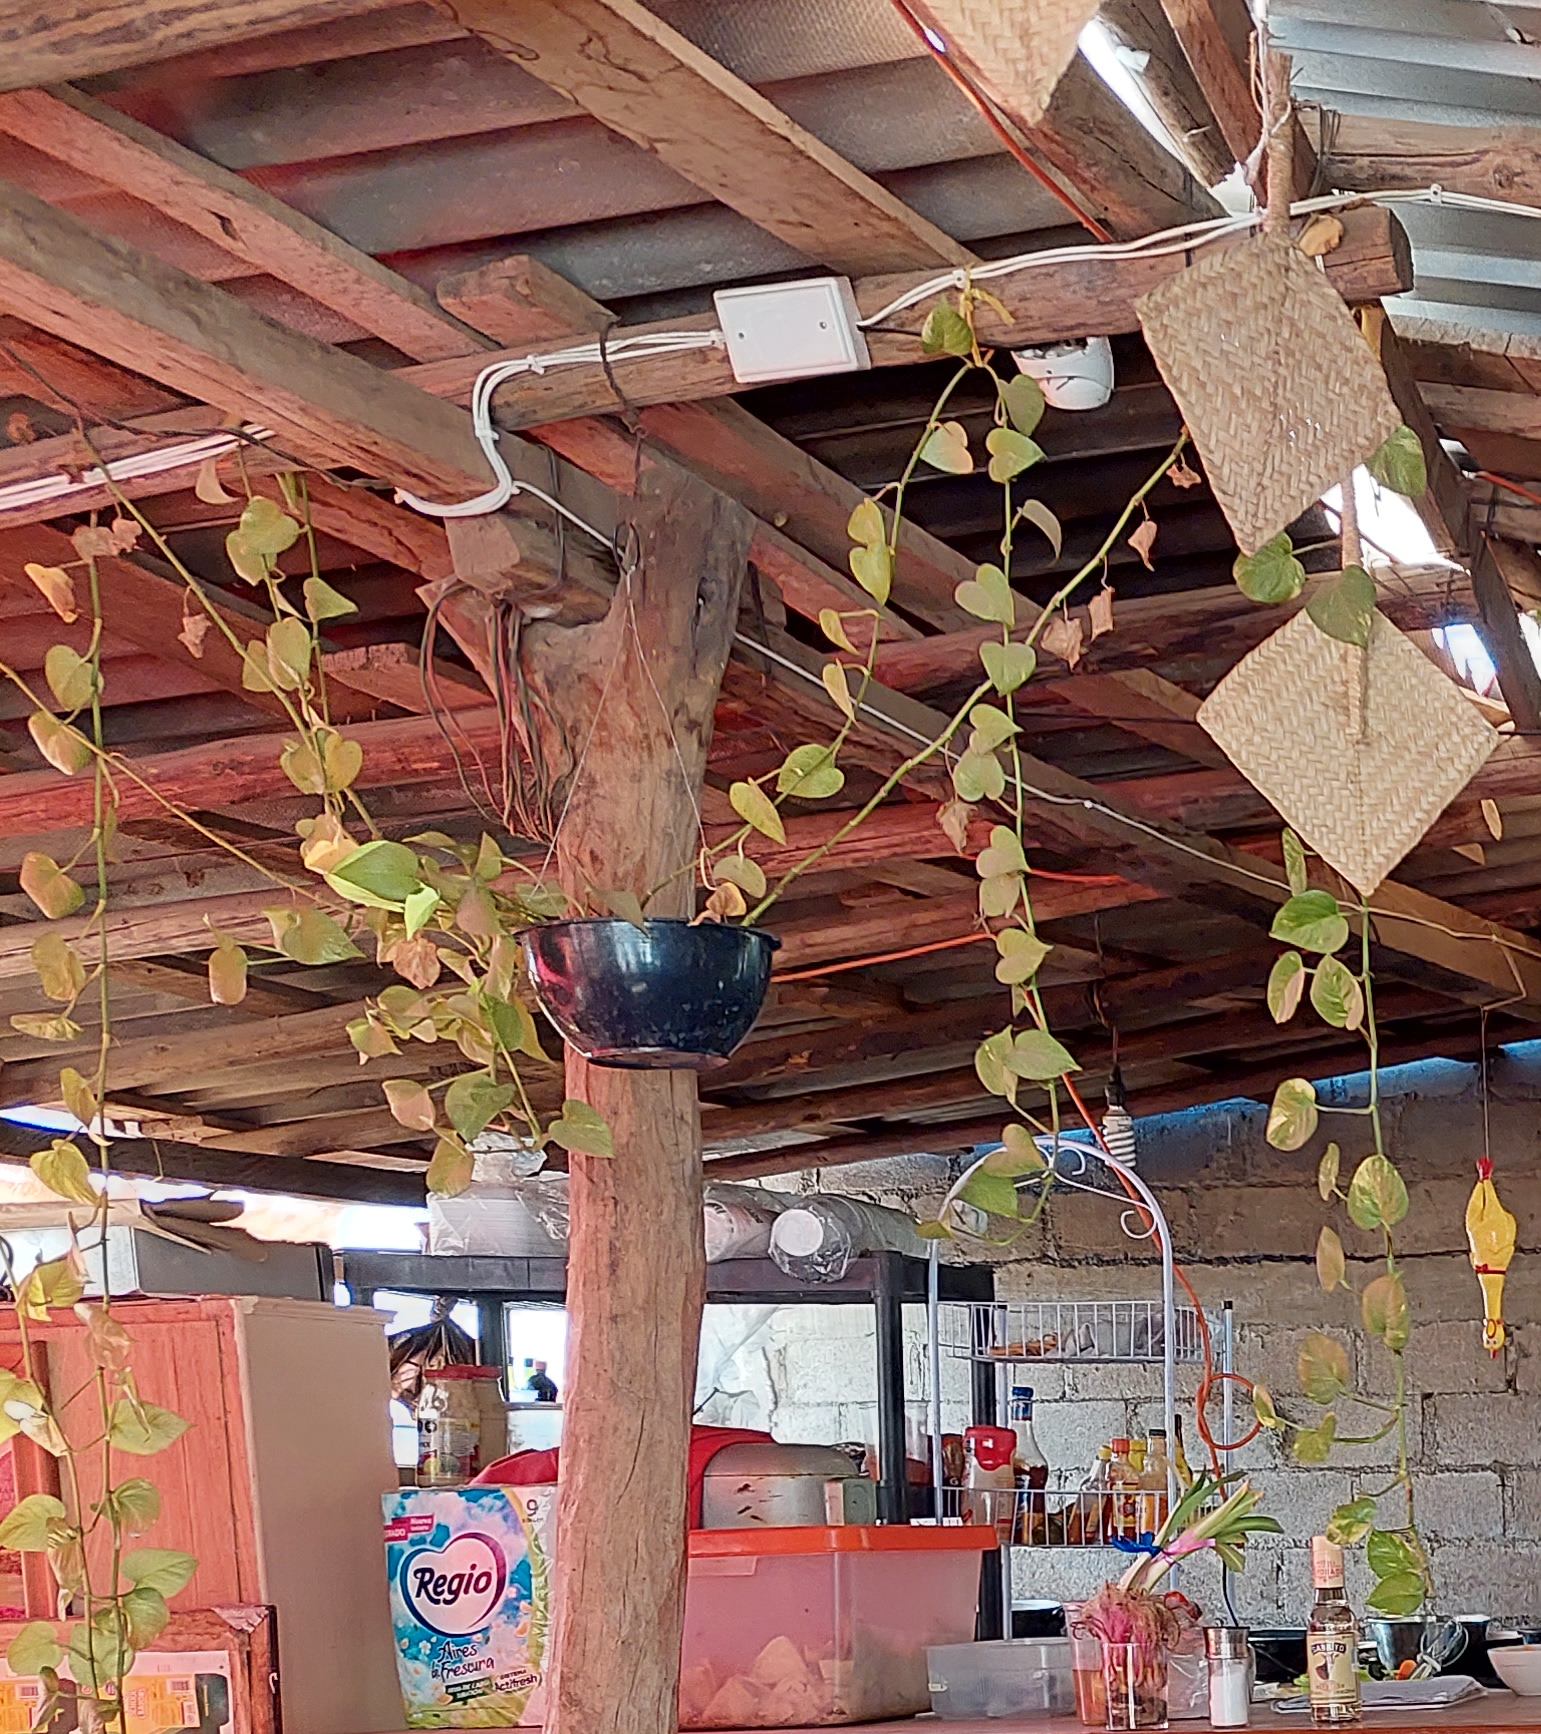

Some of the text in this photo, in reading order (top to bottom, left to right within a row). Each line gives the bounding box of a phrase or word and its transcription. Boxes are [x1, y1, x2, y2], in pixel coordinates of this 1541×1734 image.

[526, 1498, 539, 1517] 9
[413, 1563, 493, 1606] Regio
[437, 1640, 478, 1663] Aires
[440, 1656, 495, 1683] Frescura
